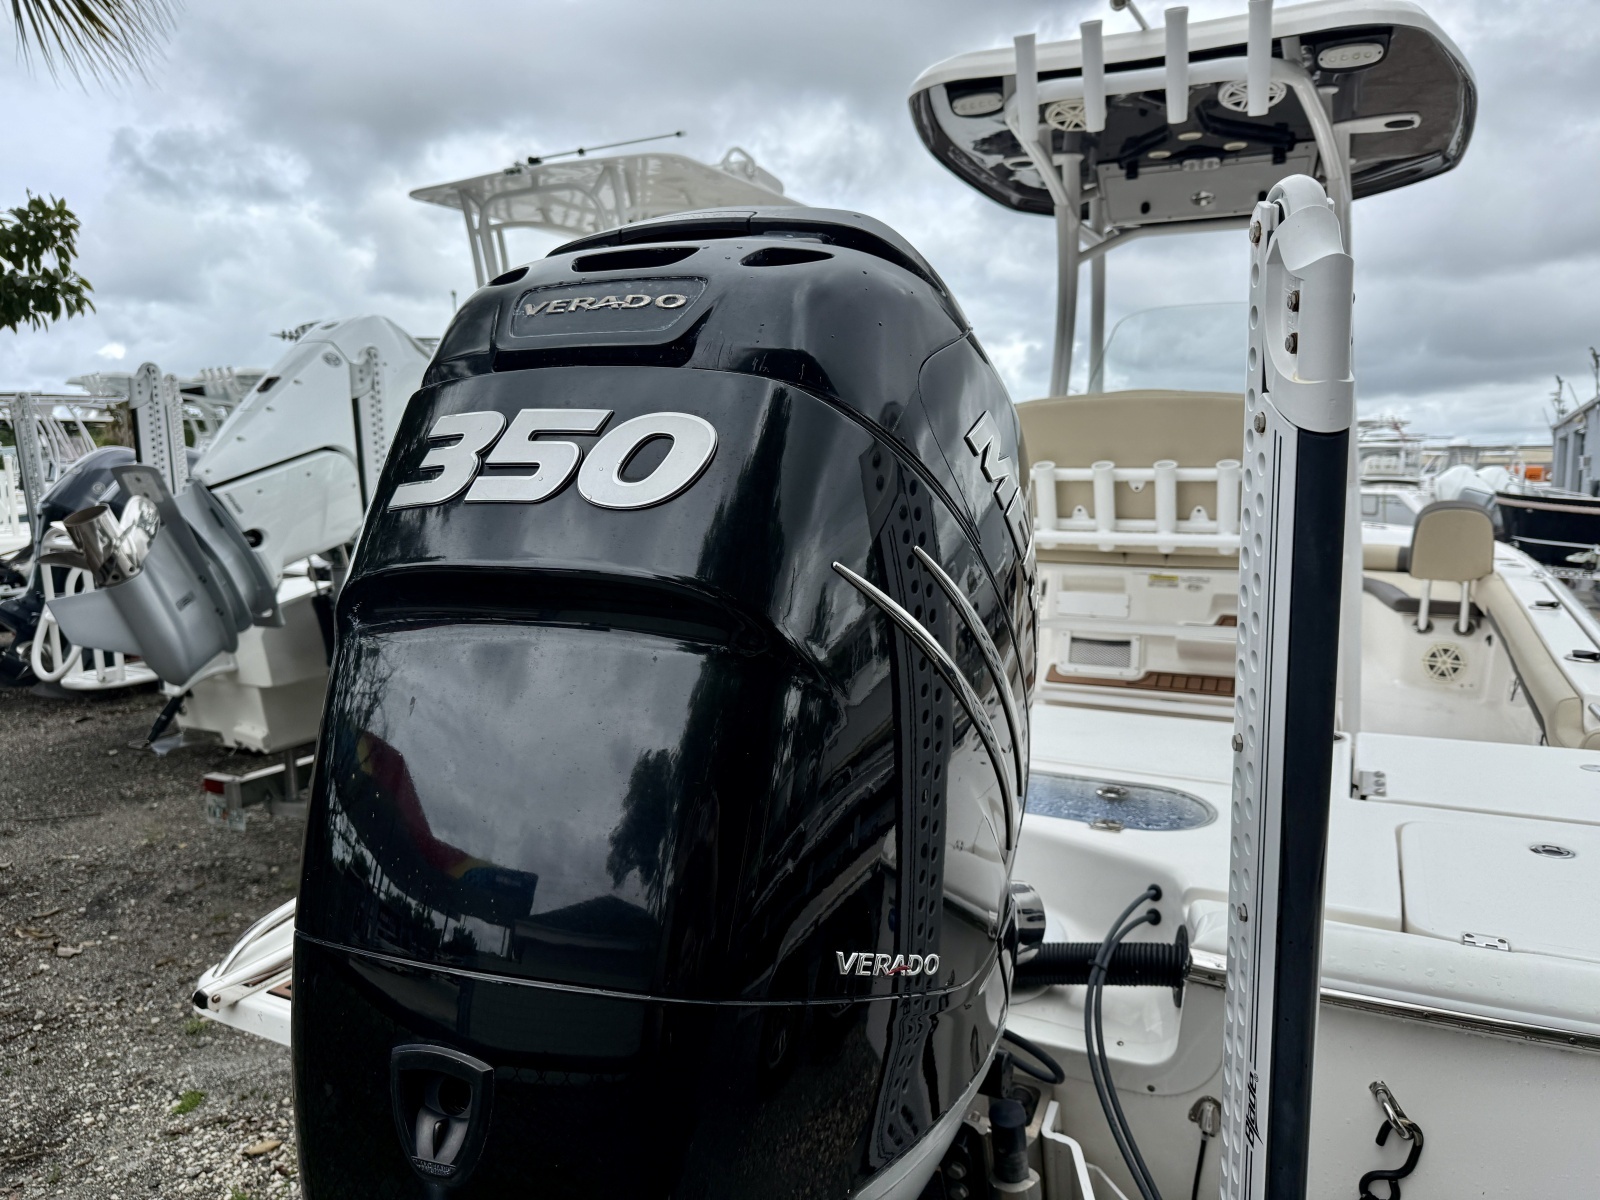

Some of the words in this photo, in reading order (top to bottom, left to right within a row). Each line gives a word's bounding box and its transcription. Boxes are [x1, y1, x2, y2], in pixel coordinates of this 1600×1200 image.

[524, 293, 687, 317] VERADO
[388, 408, 718, 510] 350
[836, 951, 940, 976] VERADO
